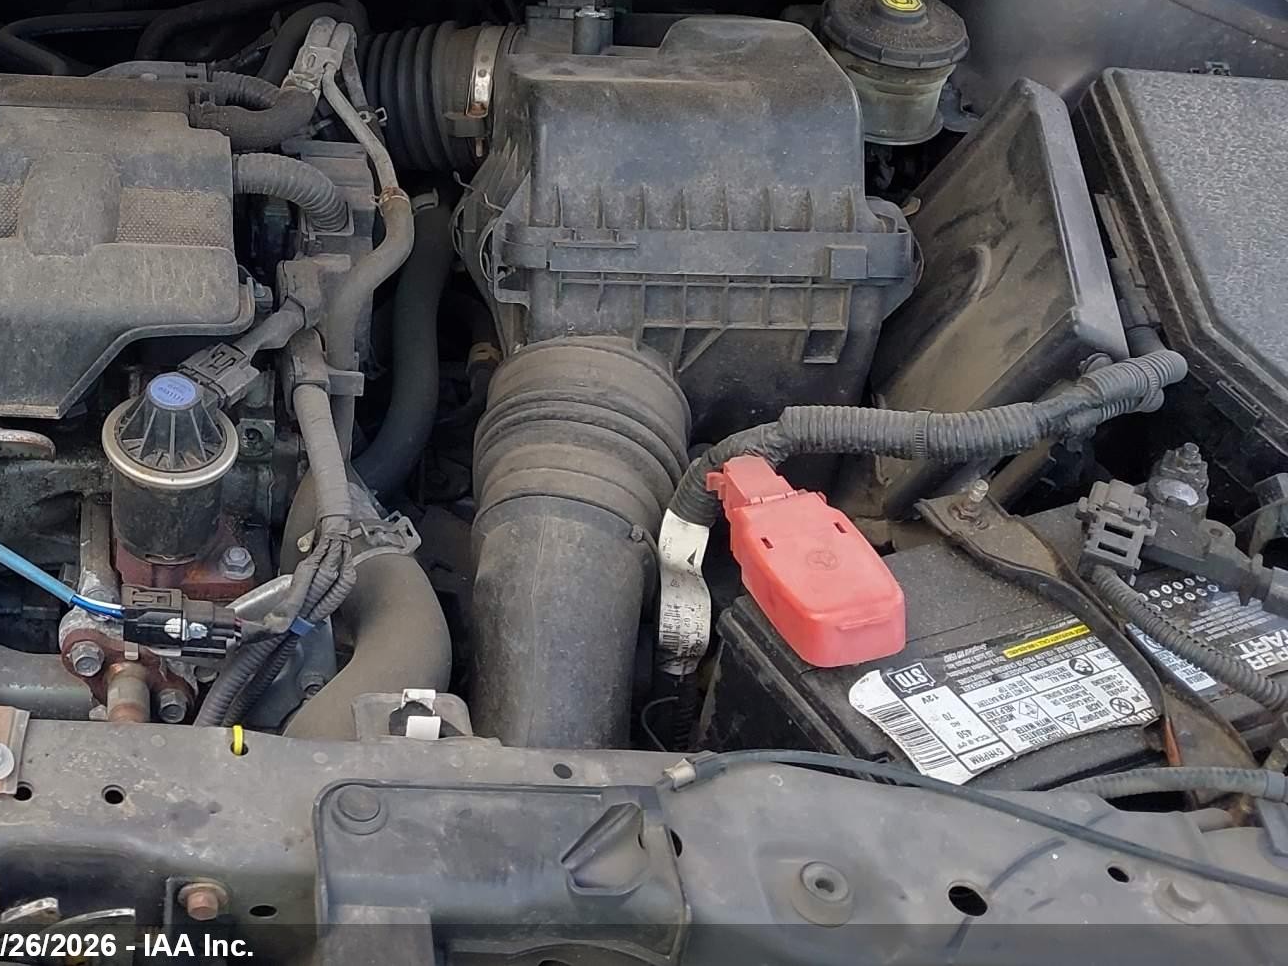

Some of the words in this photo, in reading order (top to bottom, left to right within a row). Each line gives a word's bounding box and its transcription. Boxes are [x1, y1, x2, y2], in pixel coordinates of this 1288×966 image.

[894, 667, 928, 688] STD
[921, 694, 939, 704] 12V
[942, 712, 955, 721] 70
[956, 729, 972, 739] 450
